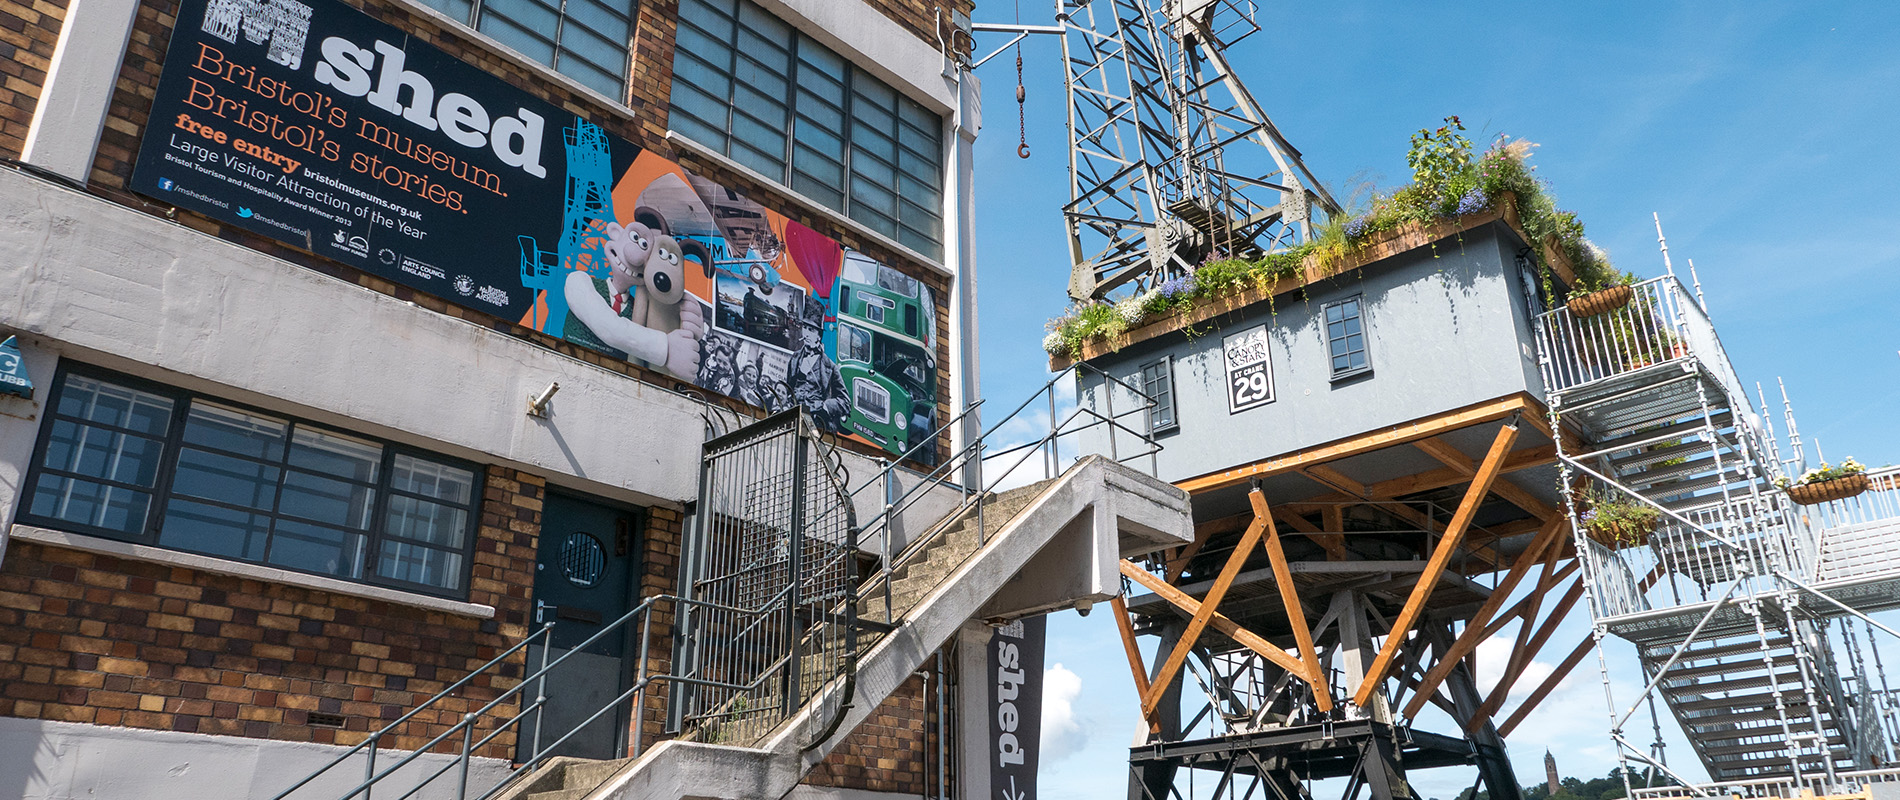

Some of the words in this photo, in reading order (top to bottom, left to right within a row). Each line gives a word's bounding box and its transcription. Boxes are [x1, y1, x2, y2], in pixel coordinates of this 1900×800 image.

[191, 42, 347, 128] Bristol's
[356, 117, 508, 198] museum.
[314, 36, 547, 179] shed
[175, 113, 228, 144] free
[233, 138, 301, 173] entry
[303, 168, 423, 221] bristolmuseums.org.uk
[183, 76, 340, 161] Bristol's
[351, 152, 468, 215] stories.
[165, 153, 193, 168] Bristol
[194, 163, 226, 181] Tourism
[227, 176, 242, 187] and
[243, 181, 283, 203] Hospitality
[283, 197, 308, 211] Award
[308, 205, 335, 220] Winner
[335, 215, 352, 227] 2013
[170, 133, 219, 162] Large
[224, 153, 274, 182] Visitor
[276, 175, 351, 213] Attraction
[354, 206, 369, 219] of
[371, 211, 394, 229] the
[397, 219, 428, 240] Year
[173, 184, 229, 210] /mshedbristol
[253, 212, 307, 237] @mshedbristol
[401, 265, 431, 280] ENGLAND
[402, 259, 419, 270] ARTS
[420, 265, 446, 280] COUNCIL
[1228, 342, 1265, 360] CANOPY
[1234, 370, 1242, 379] AT
[1243, 364, 1264, 376] CRANE
[1234, 372, 1268, 405] 29
[998, 640, 1025, 768] shed
